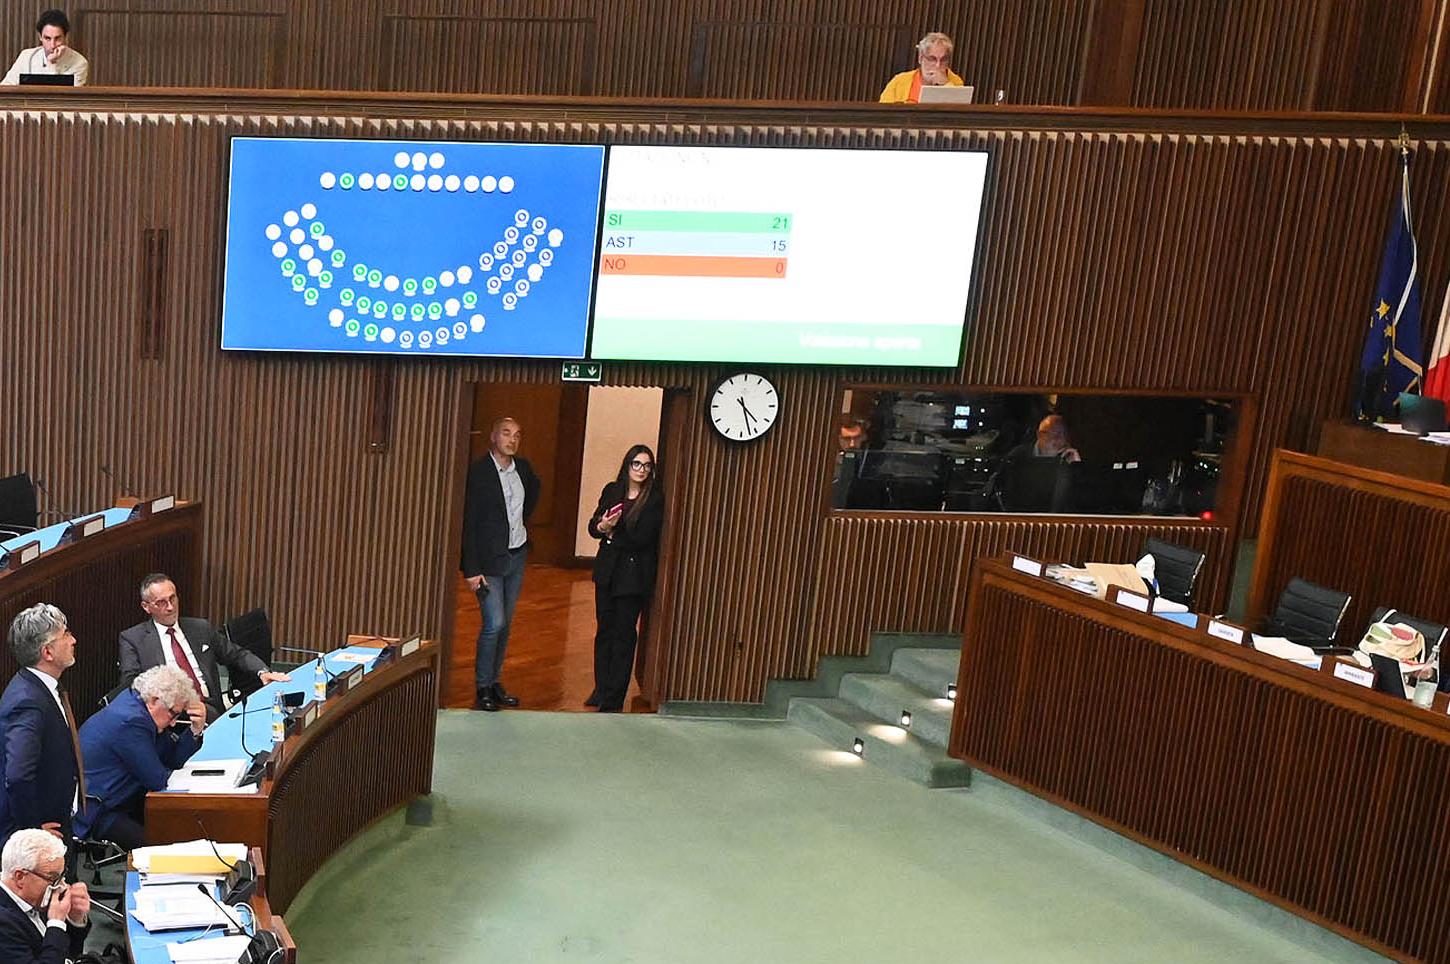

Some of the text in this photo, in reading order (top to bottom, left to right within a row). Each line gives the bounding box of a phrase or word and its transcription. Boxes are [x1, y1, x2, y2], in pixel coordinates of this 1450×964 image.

[608, 213, 788, 229] SI 21
[606, 236, 787, 252] AST 15
[604, 258, 784, 274] NO 0
